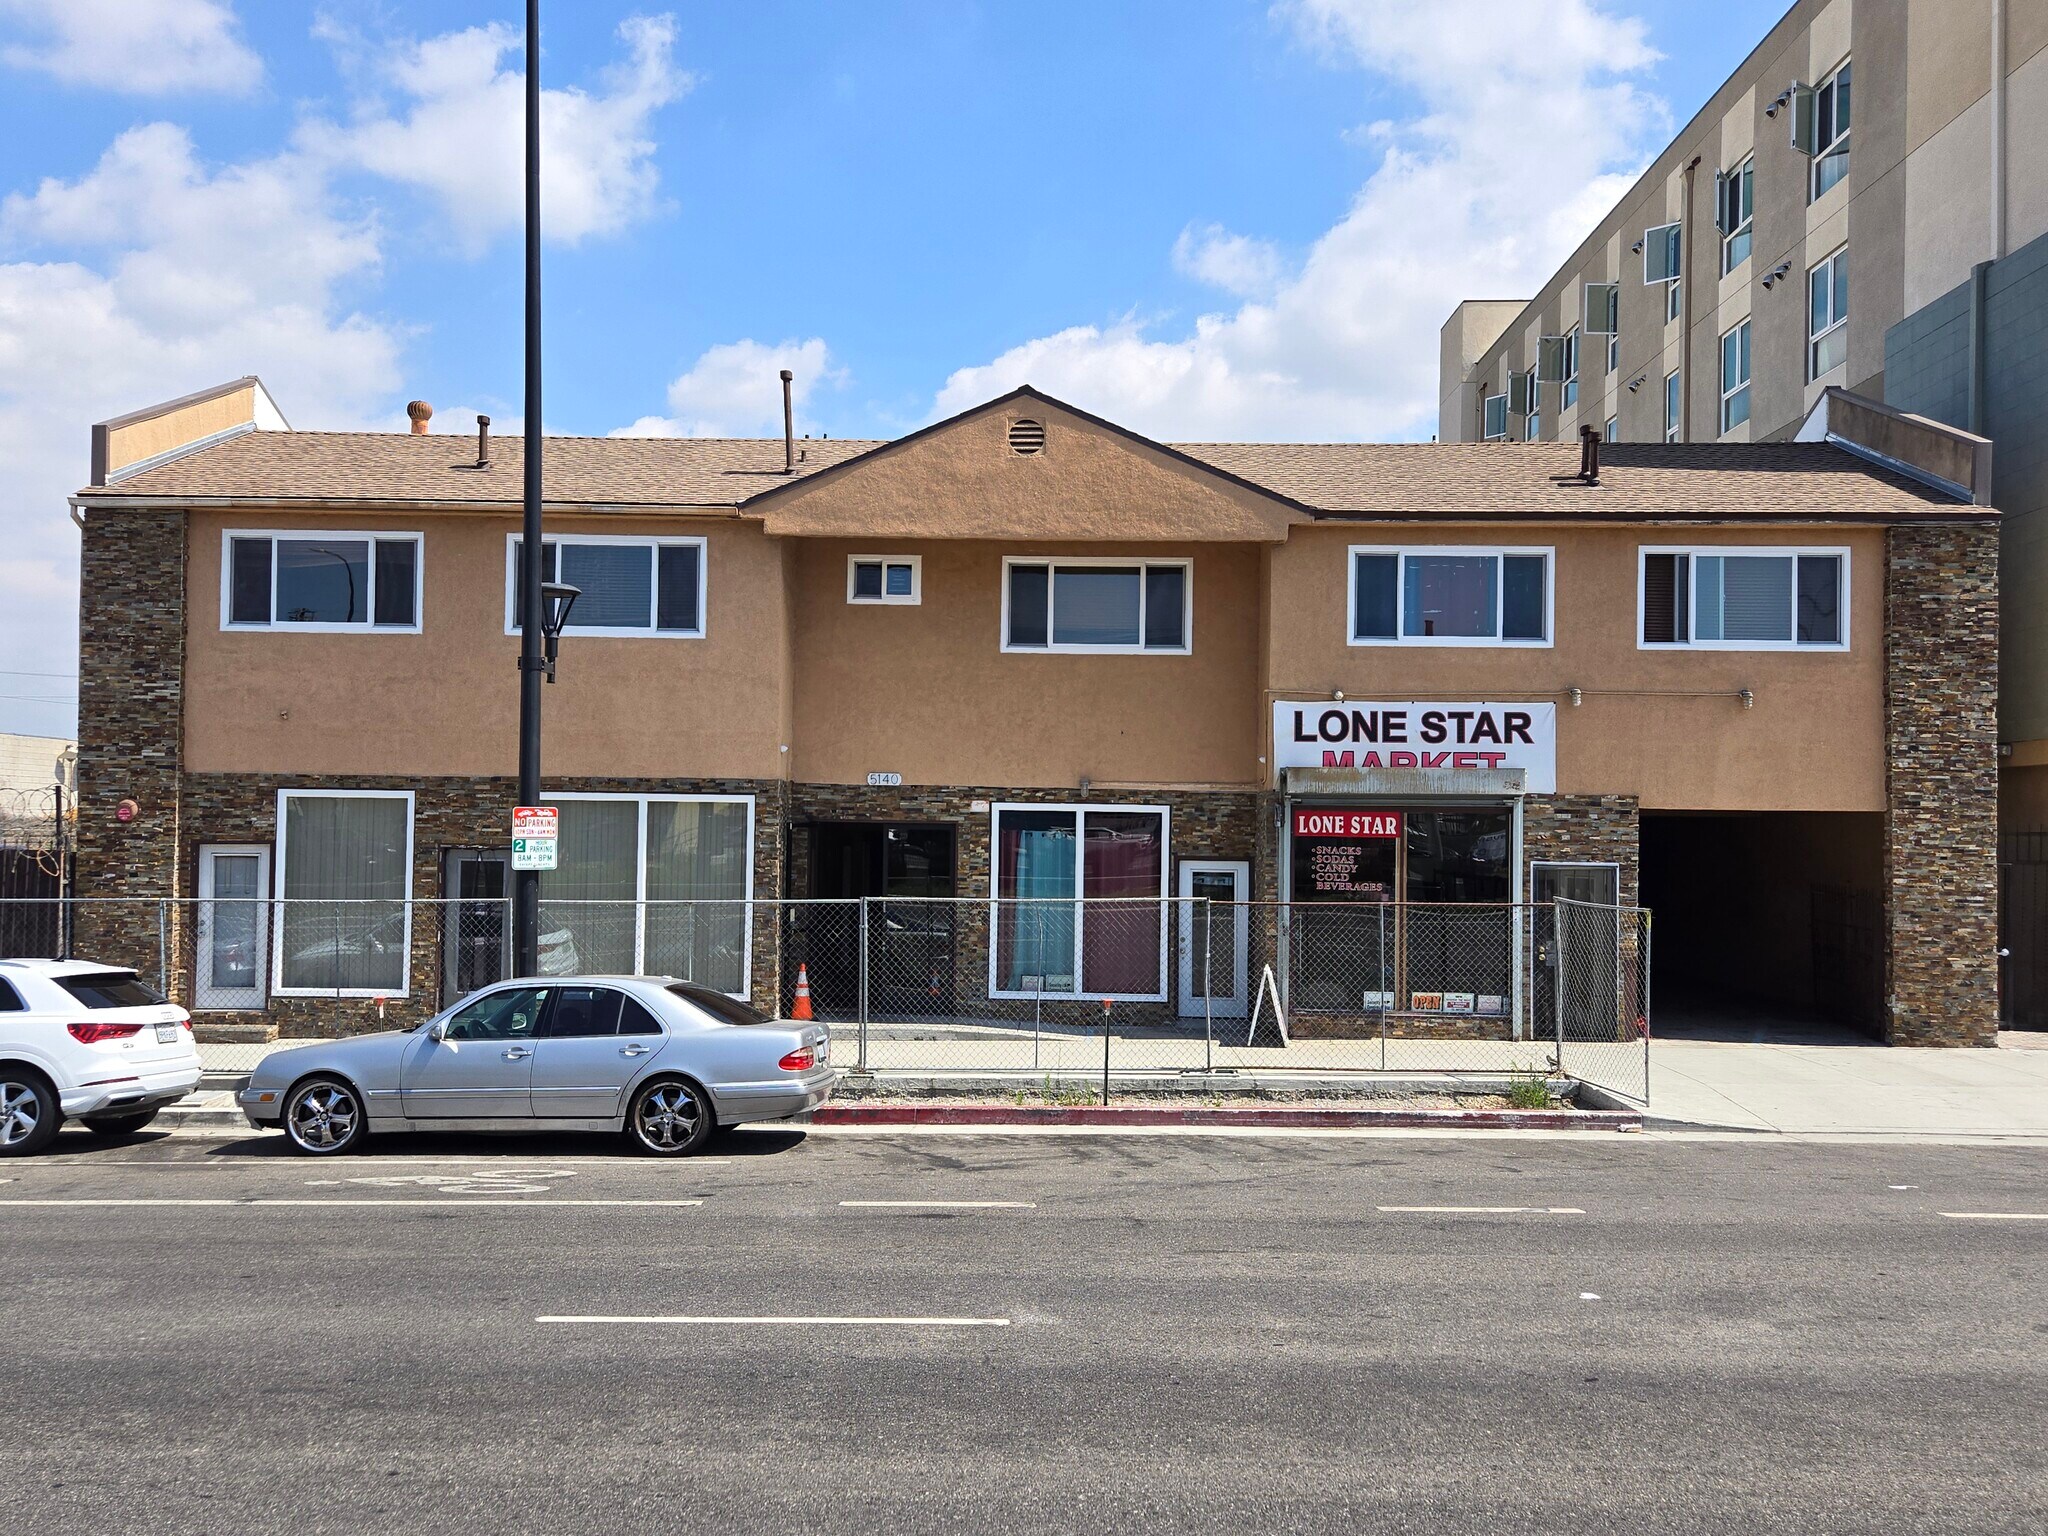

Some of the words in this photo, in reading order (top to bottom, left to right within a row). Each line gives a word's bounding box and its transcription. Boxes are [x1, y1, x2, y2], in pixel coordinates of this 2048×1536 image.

[1293, 709, 1408, 743] LONE
[1420, 710, 1535, 744] STAR
[870, 774, 899, 785] 5140
[515, 818, 526, 827] NO
[528, 819, 556, 827] PARKING
[1298, 815, 1345, 834] LONE
[1350, 815, 1397, 835] STAR
[515, 840, 524, 851] 2
[1315, 846, 1362, 855] SNACKS
[517, 854, 532, 862] 8AM
[538, 854, 553, 862] 8PM
[1315, 855, 1355, 864] SODAS
[1315, 864, 1358, 873] CANDY
[1315, 873, 1350, 882] COLD
[1316, 881, 1383, 892] BEVERAGES
[1412, 995, 1441, 1010] OPEN
